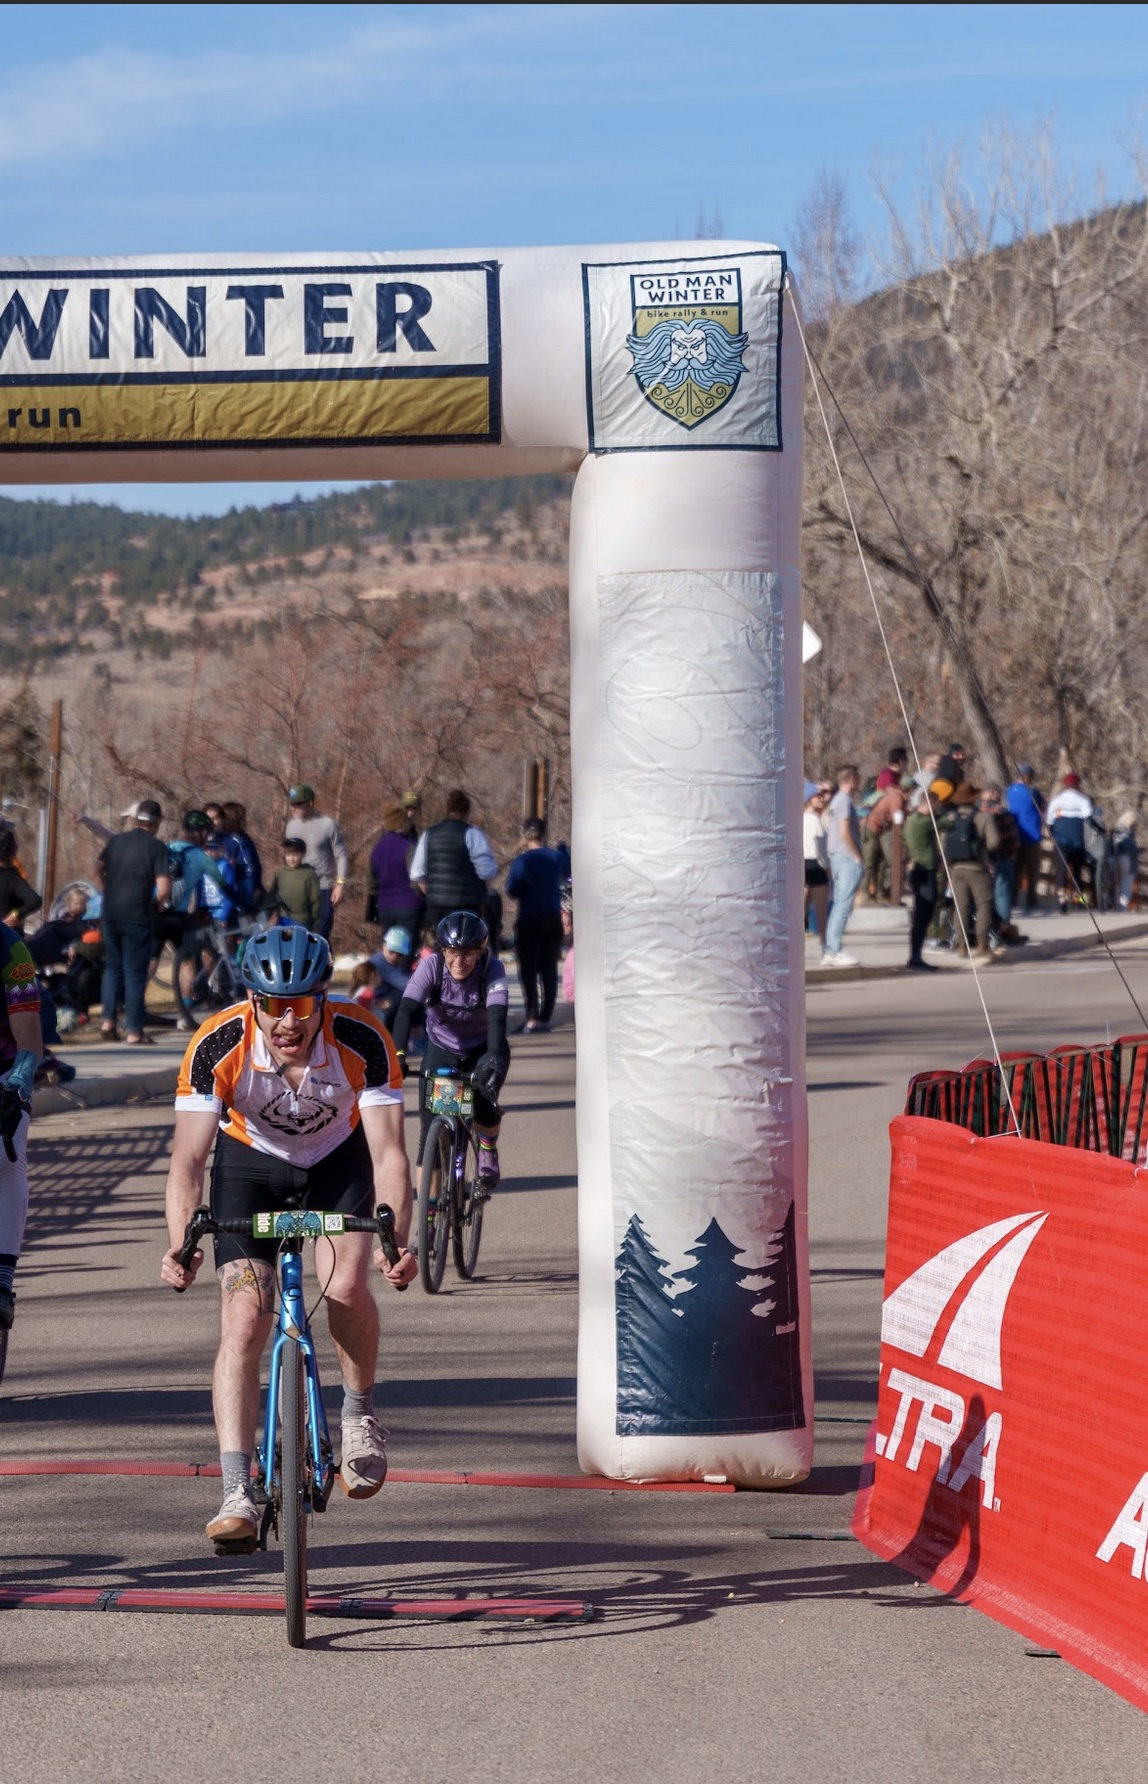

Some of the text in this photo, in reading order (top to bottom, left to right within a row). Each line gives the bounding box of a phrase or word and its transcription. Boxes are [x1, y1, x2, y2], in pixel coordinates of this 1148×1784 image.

[640, 274, 732, 290] OLD MAN
[648, 288, 725, 302] WINTER
[647, 308, 728, 318] bike rally & run
[7, 405, 82, 429] run
[1095, 1470, 1148, 1584] A
